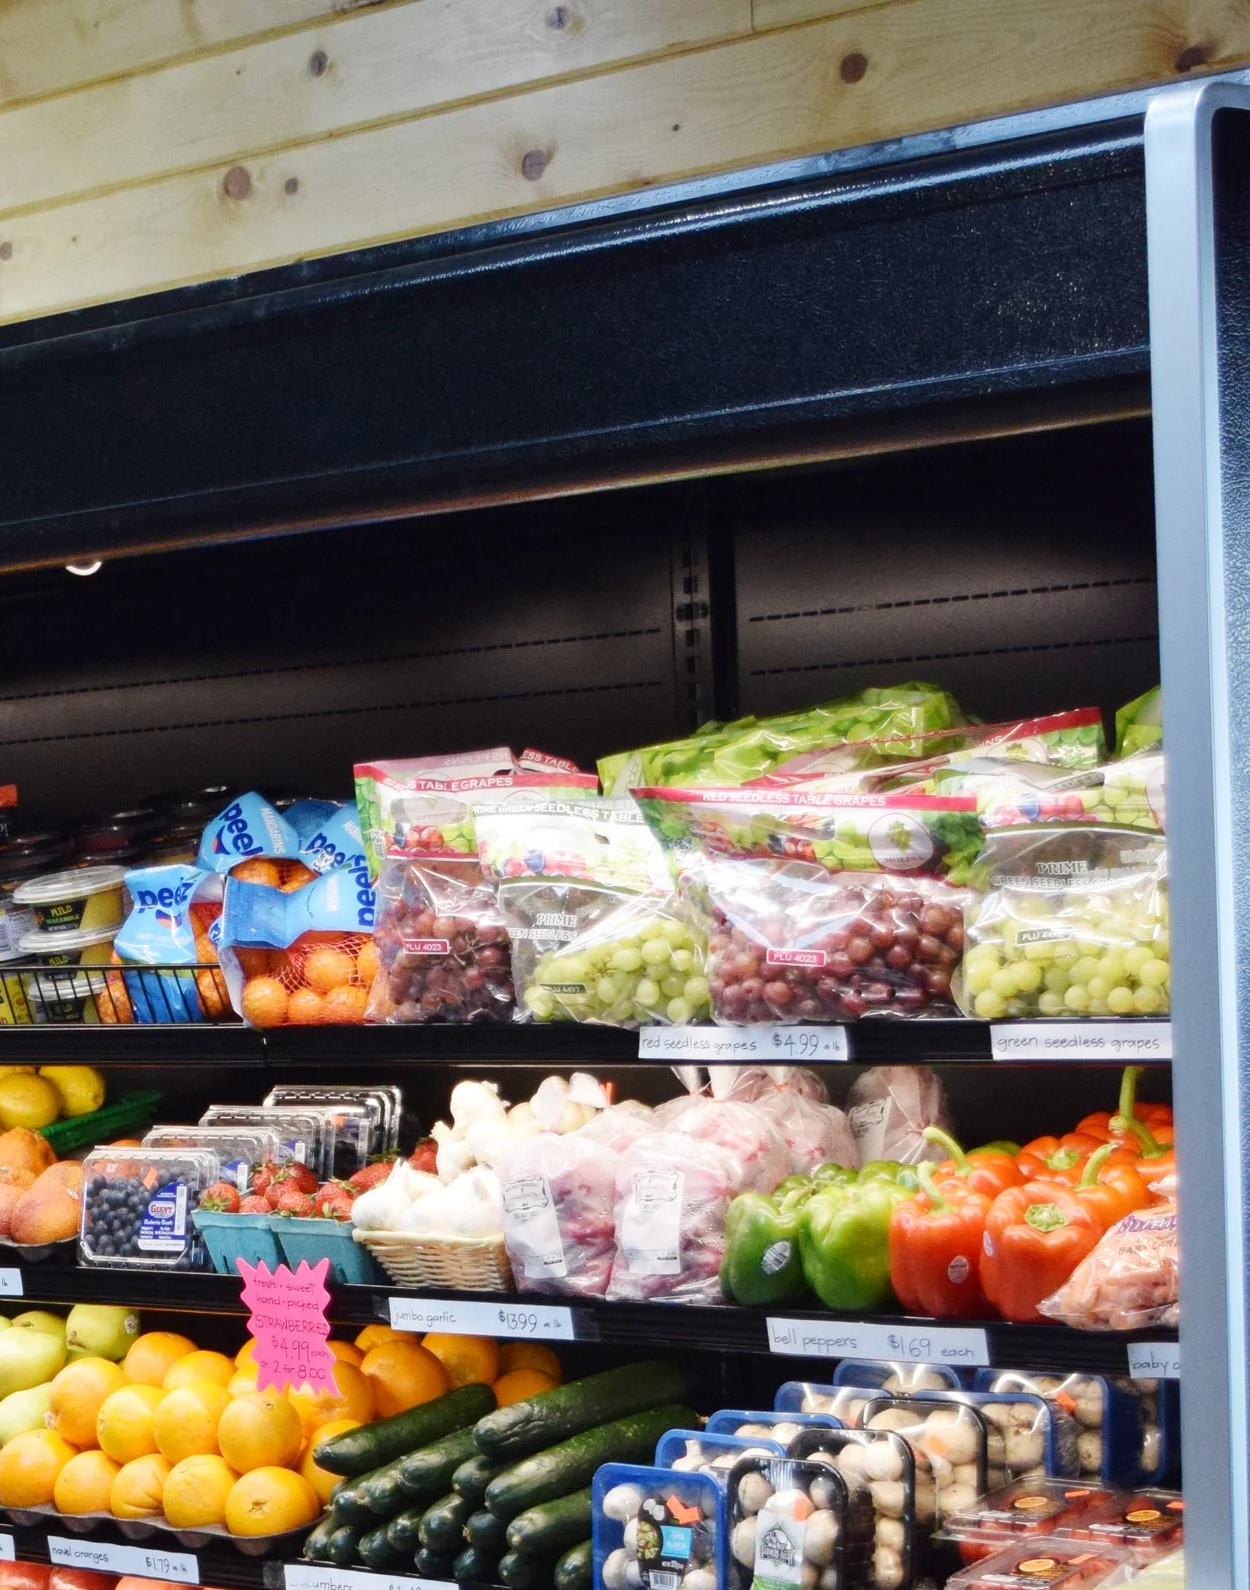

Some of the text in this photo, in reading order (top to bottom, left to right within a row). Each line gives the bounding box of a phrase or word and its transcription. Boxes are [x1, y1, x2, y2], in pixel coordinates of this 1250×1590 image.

[461, 777, 513, 790] GRAPES
[702, 792, 886, 807] RED SEEDLESS TABLE GRAPES
[603, 810, 644, 824] TABLE
[1036, 861, 1089, 876] PRIME
[991, 875, 1033, 887] GREEN
[422, 943, 442, 952] 4023
[774, 952, 817, 963] PLU 4023
[641, 1037, 660, 1049] red
[664, 1036, 711, 1051] seedless
[713, 1040, 757, 1056] grapes
[997, 1034, 1161, 1053] green seedless grapes
[254, 1277, 315, 1294] fresh sweet
[256, 1292, 319, 1313] hand-picked
[392, 1305, 424, 1326] jumbo
[426, 1310, 457, 1328] garlic
[255, 1313, 328, 1337] STRAWBERRIES
[271, 1335, 329, 1363] $4.99 each
[771, 1325, 797, 1346] bell
[802, 1335, 858, 1352] peppers
[940, 1346, 975, 1358] each
[273, 1360, 281, 1374] 2
[283, 1363, 296, 1374] for
[1131, 1350, 1169, 1376] baby
[74, 1550, 109, 1564] oranges
